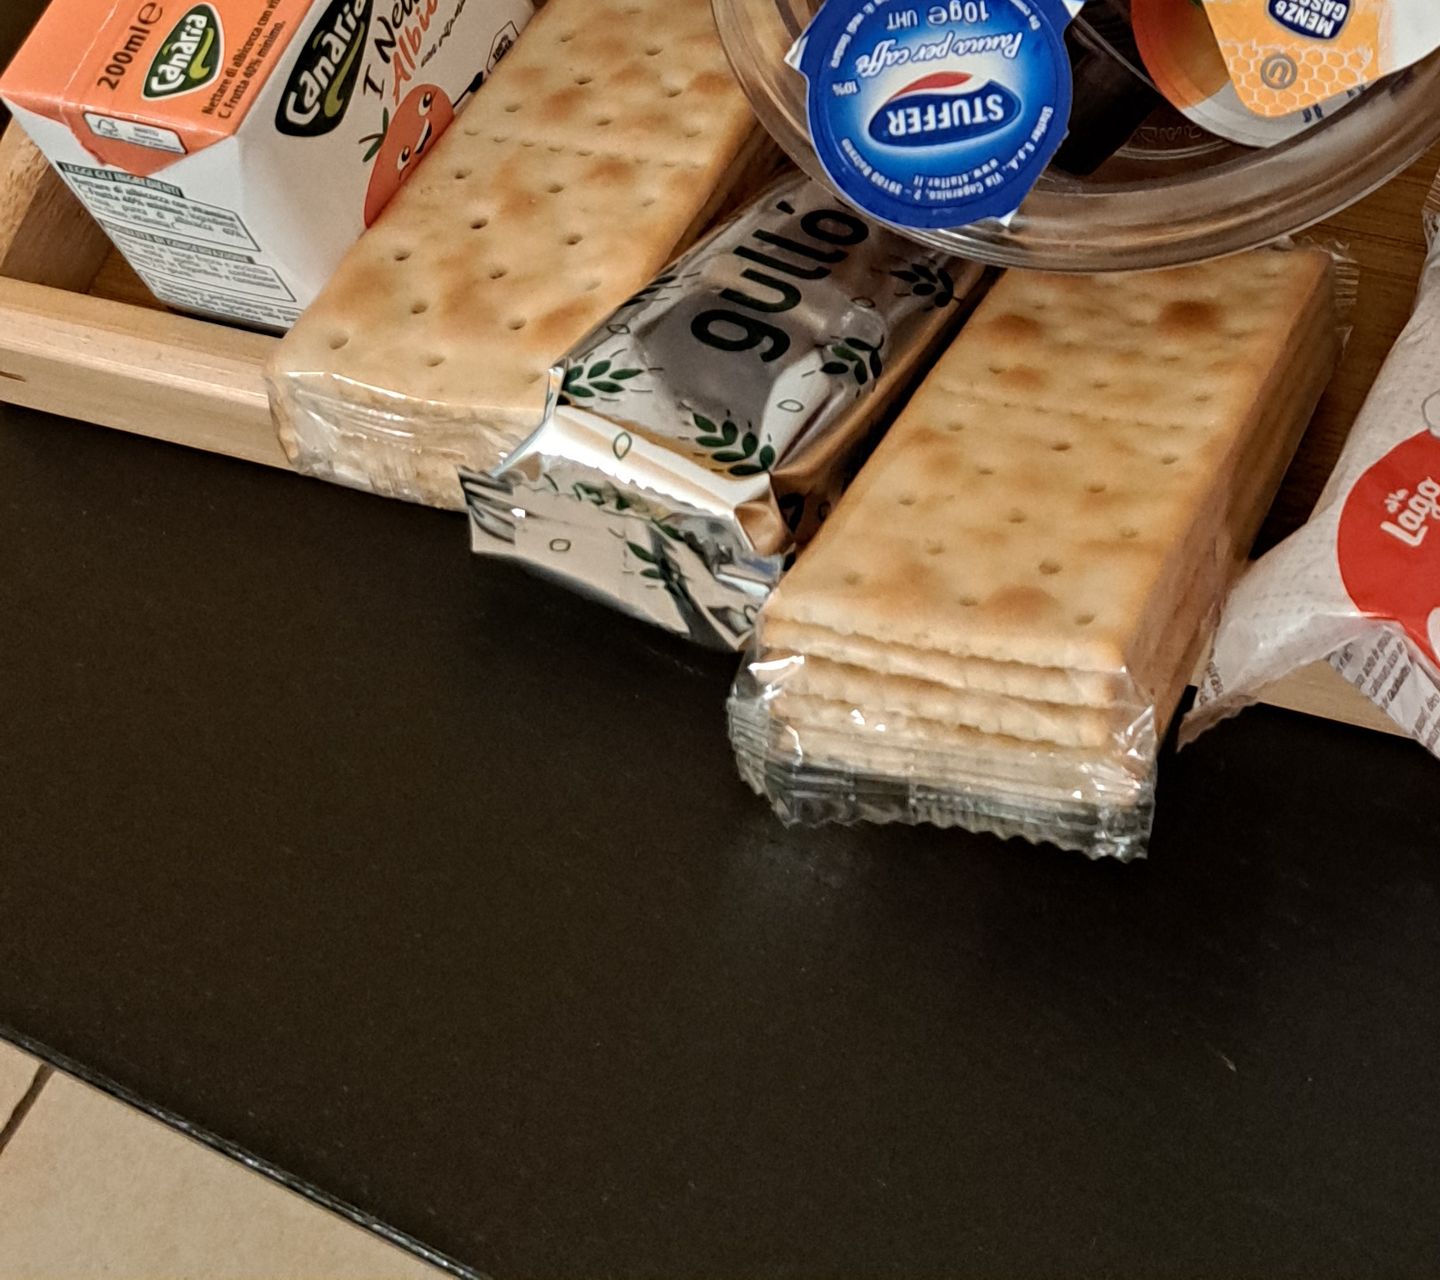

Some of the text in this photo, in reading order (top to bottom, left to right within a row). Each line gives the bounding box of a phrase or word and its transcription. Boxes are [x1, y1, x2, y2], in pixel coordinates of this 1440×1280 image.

[887, 12, 918, 31] UHT
[150, 14, 208, 91] Canaria
[910, 30, 953, 60] per
[952, 31, 1023, 59] Panna
[363, 64, 386, 101] I
[831, 80, 859, 96] 10%
[886, 94, 1005, 136] STUFFER
